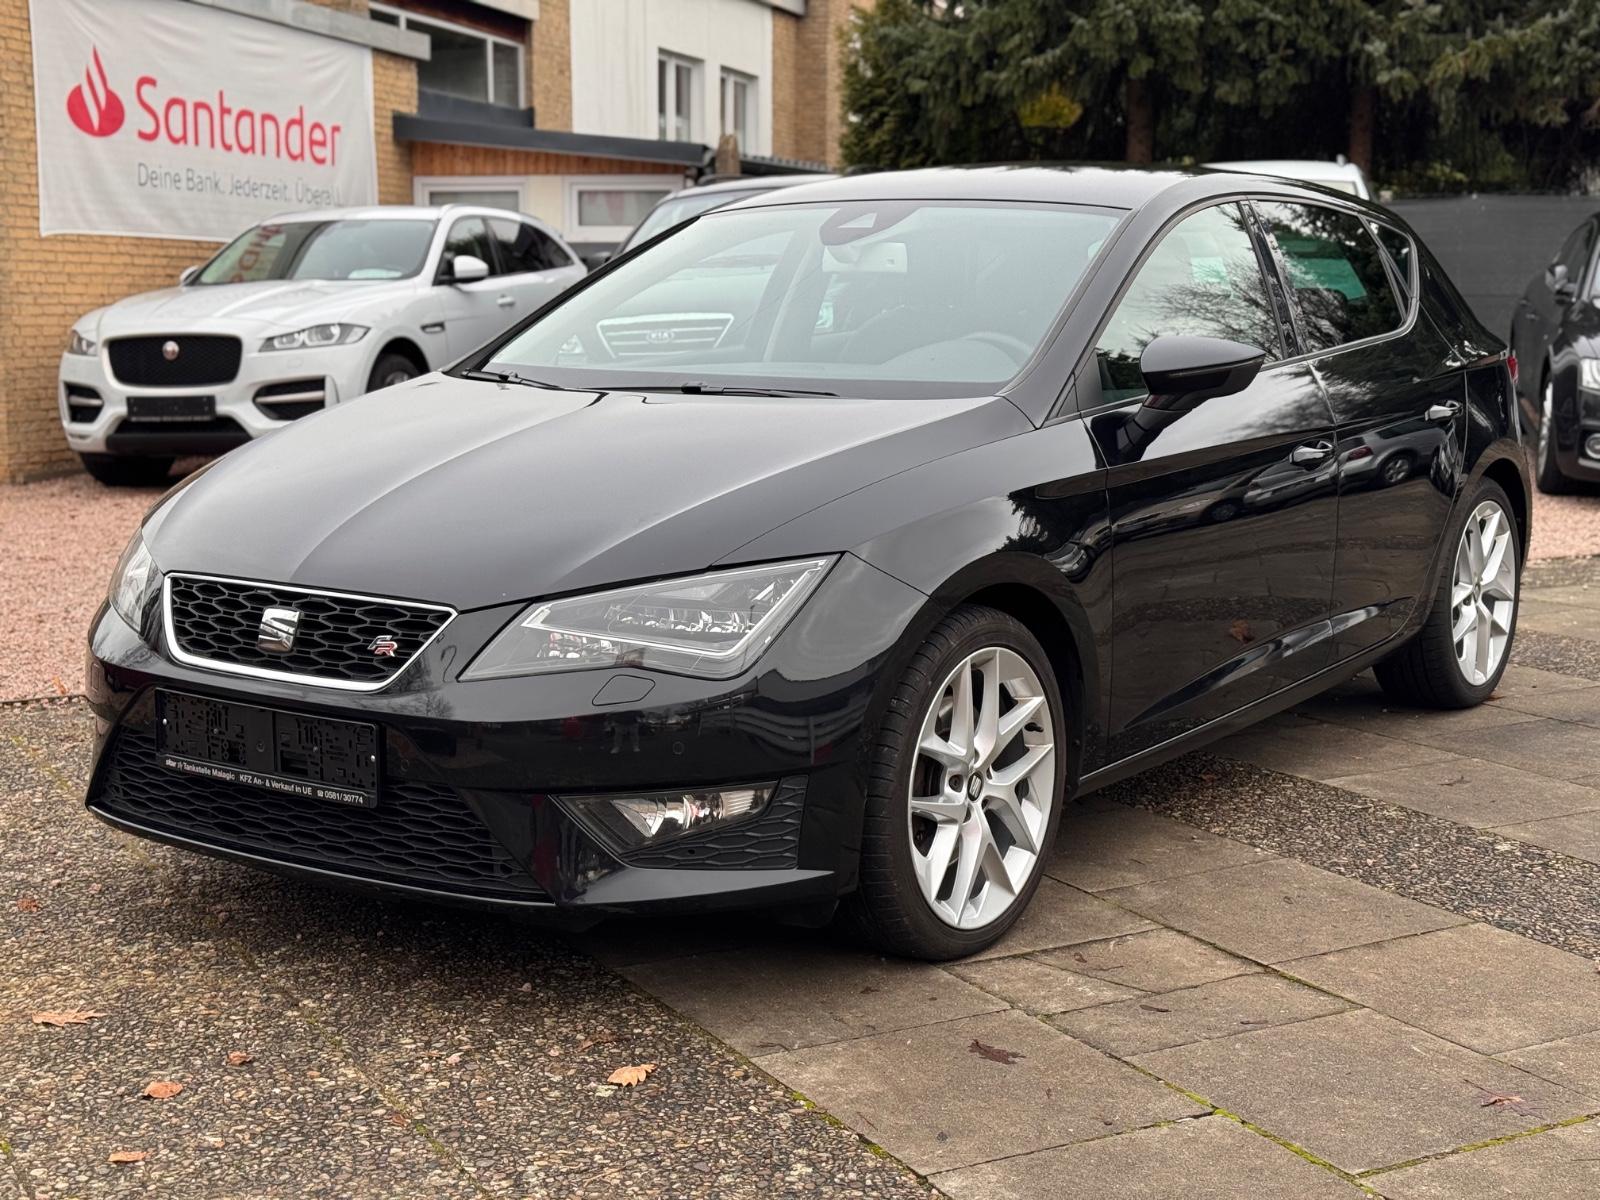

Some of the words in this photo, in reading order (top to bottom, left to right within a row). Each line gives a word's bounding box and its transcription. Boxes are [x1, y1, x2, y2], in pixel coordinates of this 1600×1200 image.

[135, 76, 341, 167] Santander
[137, 162, 182, 191] Deine
[186, 167, 225, 195] Bank.
[240, 774, 252, 784] KFZ
[253, 777, 264, 785] An-
[265, 779, 271, 787] &
[271, 781, 294, 792] Verkauf
[302, 786, 313, 795] UE
[324, 790, 363, 804] 0581/30774
